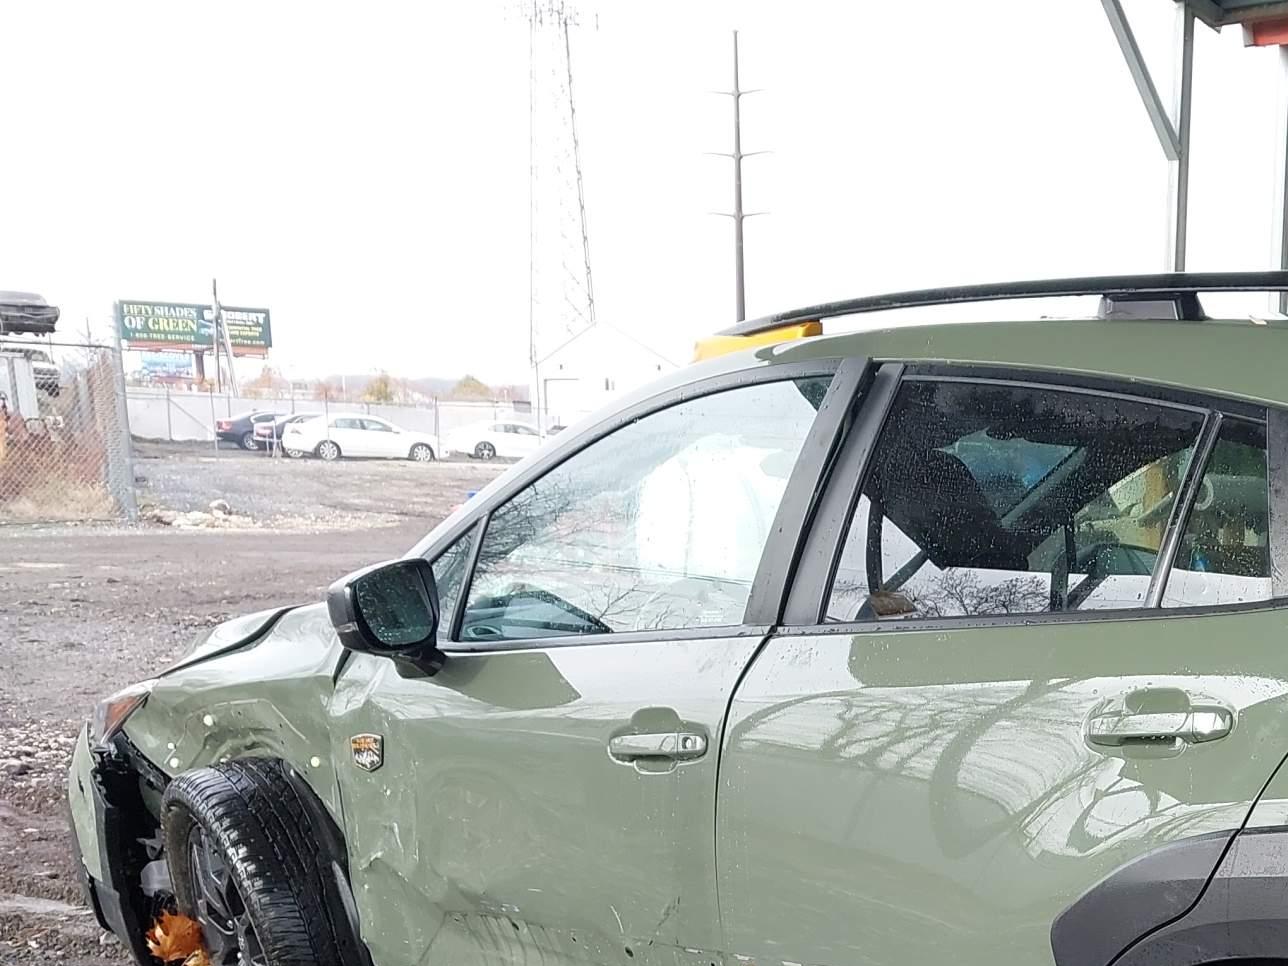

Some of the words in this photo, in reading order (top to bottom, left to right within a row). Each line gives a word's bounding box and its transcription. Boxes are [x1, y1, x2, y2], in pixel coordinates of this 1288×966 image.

[123, 304, 153, 316] FIFTY
[154, 306, 197, 319] SHADES
[124, 315, 145, 330] OF
[148, 317, 198, 332] GREEN
